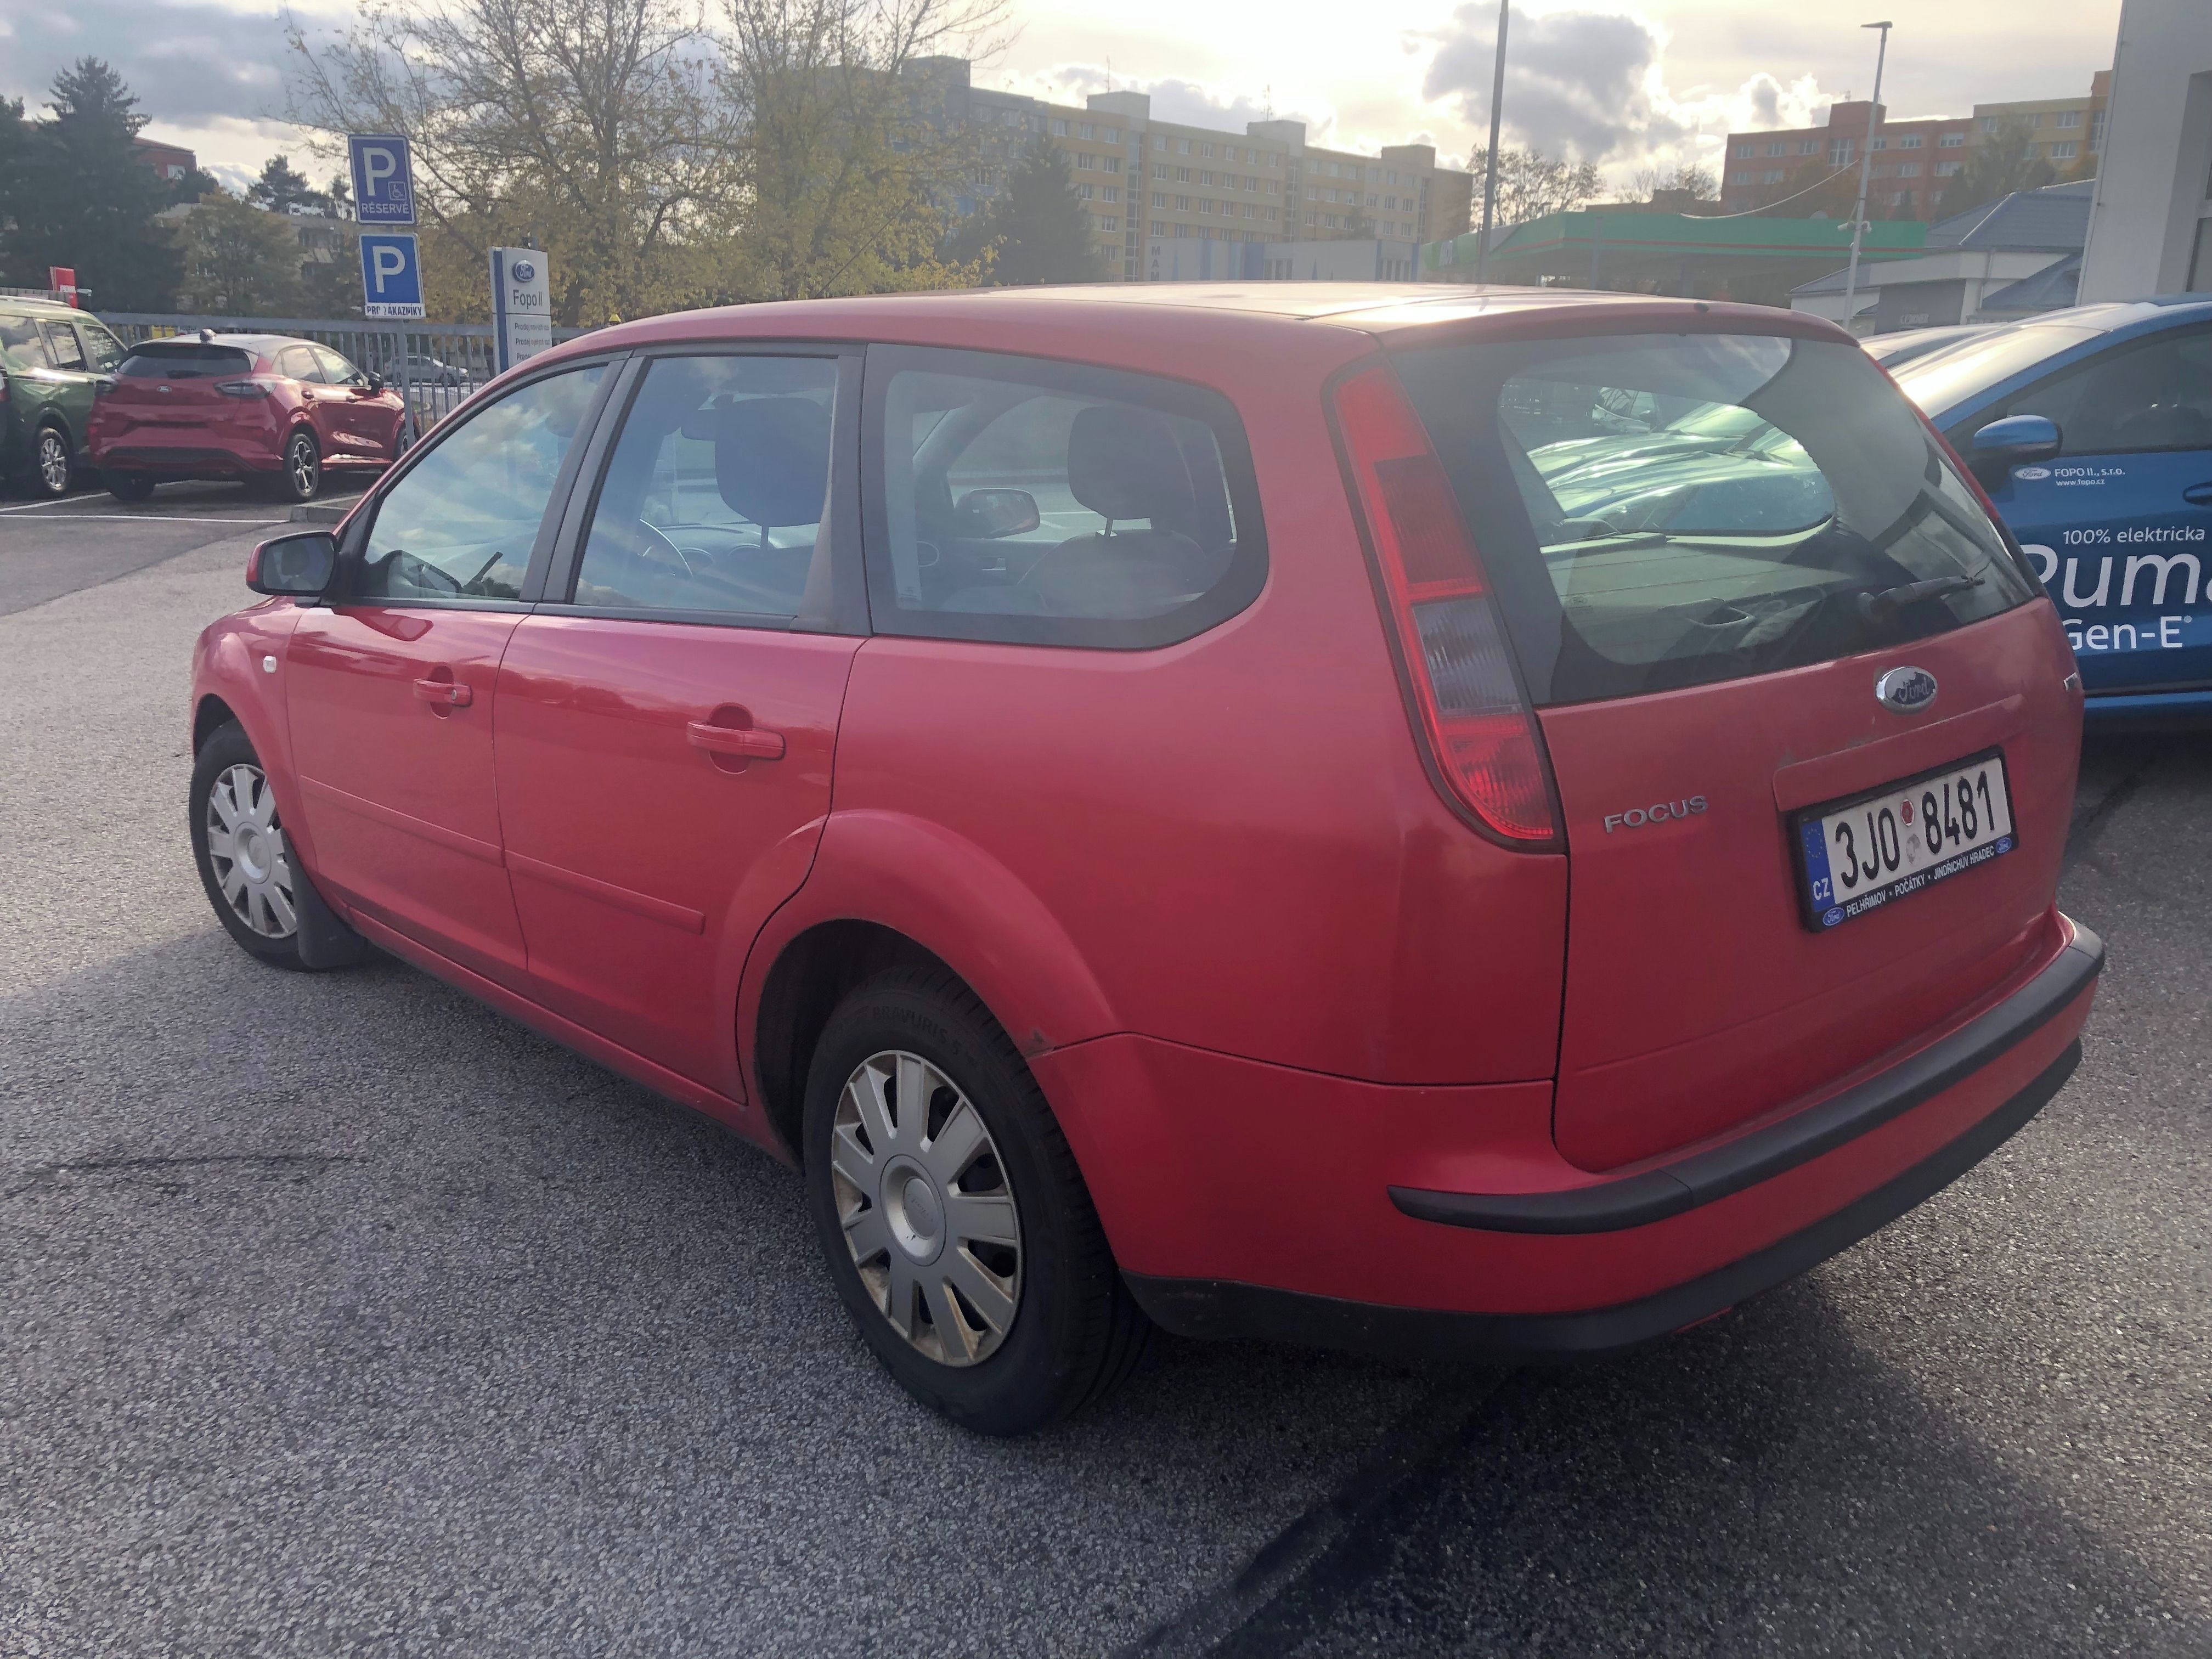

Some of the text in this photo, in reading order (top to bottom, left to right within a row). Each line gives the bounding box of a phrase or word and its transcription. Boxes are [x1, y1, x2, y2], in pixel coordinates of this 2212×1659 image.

[362, 147, 396, 196] P
[362, 201, 409, 214] RÉSERVÉ
[373, 245, 405, 294] P
[513, 289, 537, 309] Fopo
[515, 323, 530, 331] Prodej
[516, 337, 531, 347] Prodej
[2055, 468, 2085, 477] FOPO
[2063, 526, 2205, 544] 100% elektricka
[2019, 544, 2212, 608] Pum
[1604, 795, 1709, 834] FOCUS
[1922, 771, 1995, 854] 8481
[1813, 877, 1831, 900] CZ
[1846, 845, 1995, 917] PELHŘIMOV POČÁTKY JINDŘICHŮV HRADEC
